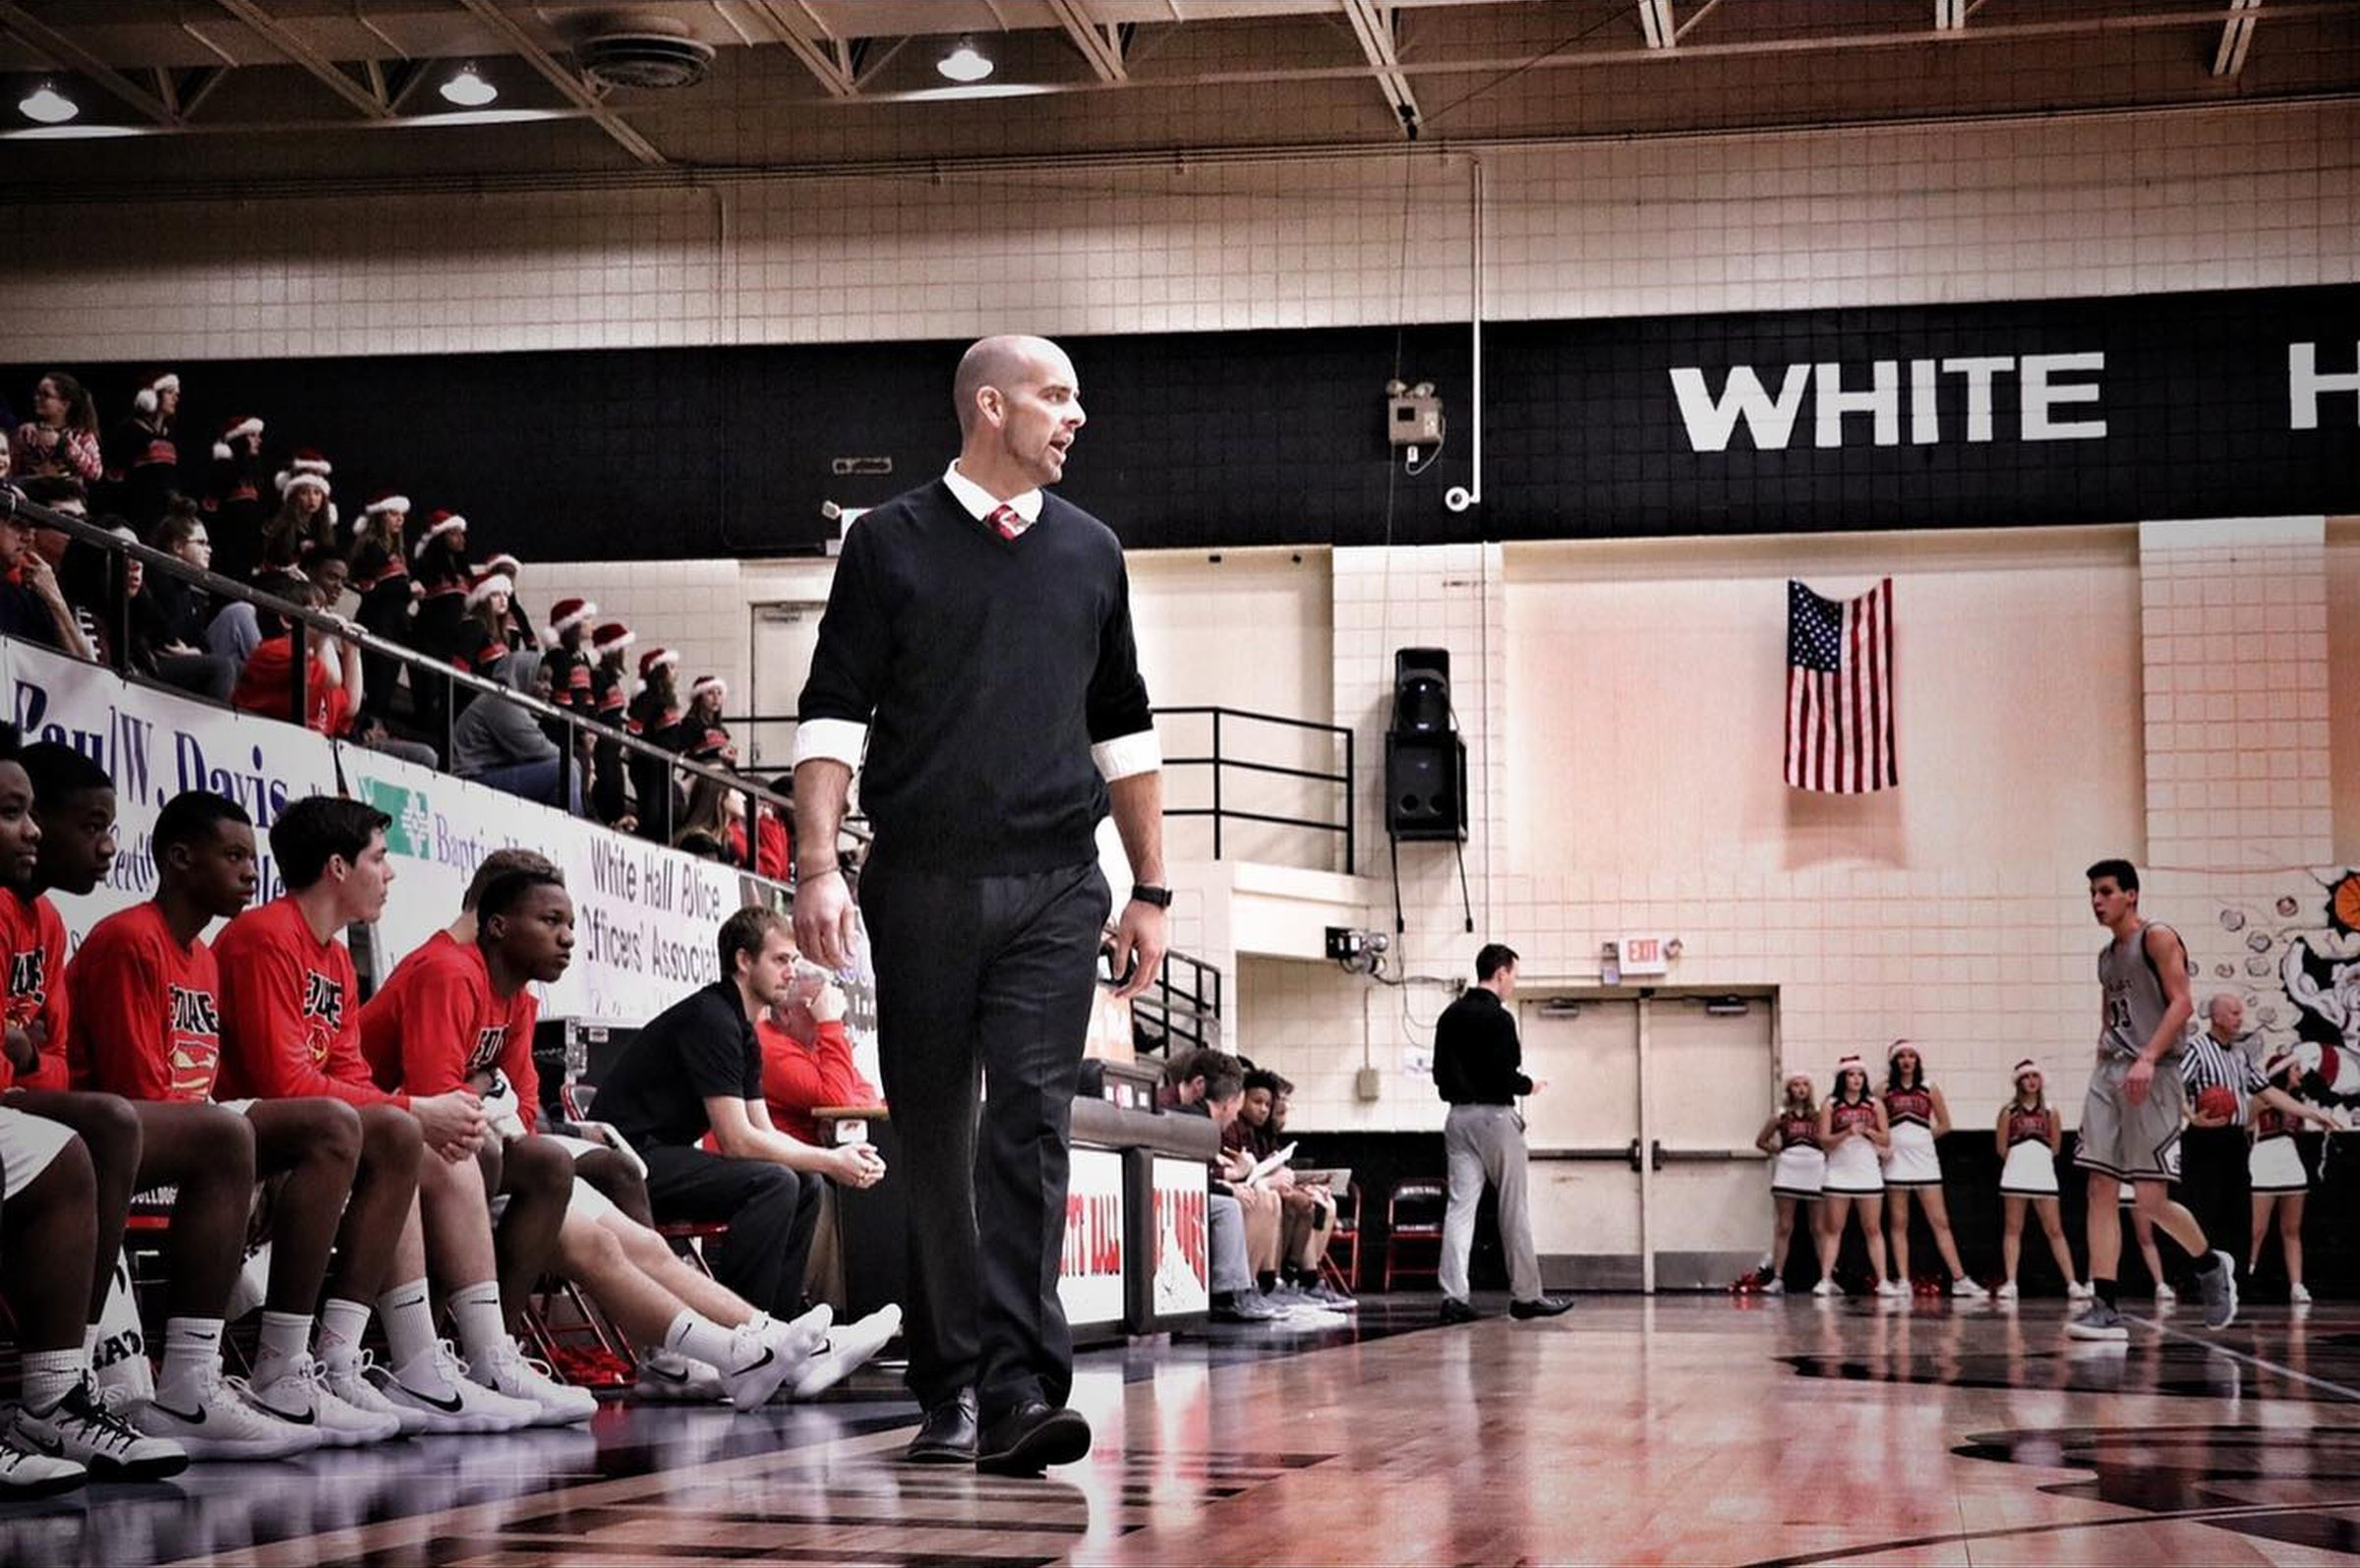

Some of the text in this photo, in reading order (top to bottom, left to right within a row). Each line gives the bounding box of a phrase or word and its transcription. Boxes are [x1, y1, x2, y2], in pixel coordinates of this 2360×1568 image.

[1669, 352, 2106, 451] WHITE
[591, 837, 637, 902] White
[644, 853, 674, 911] Hall
[680, 863, 720, 923] Police
[1627, 939, 1658, 962] EXIT
